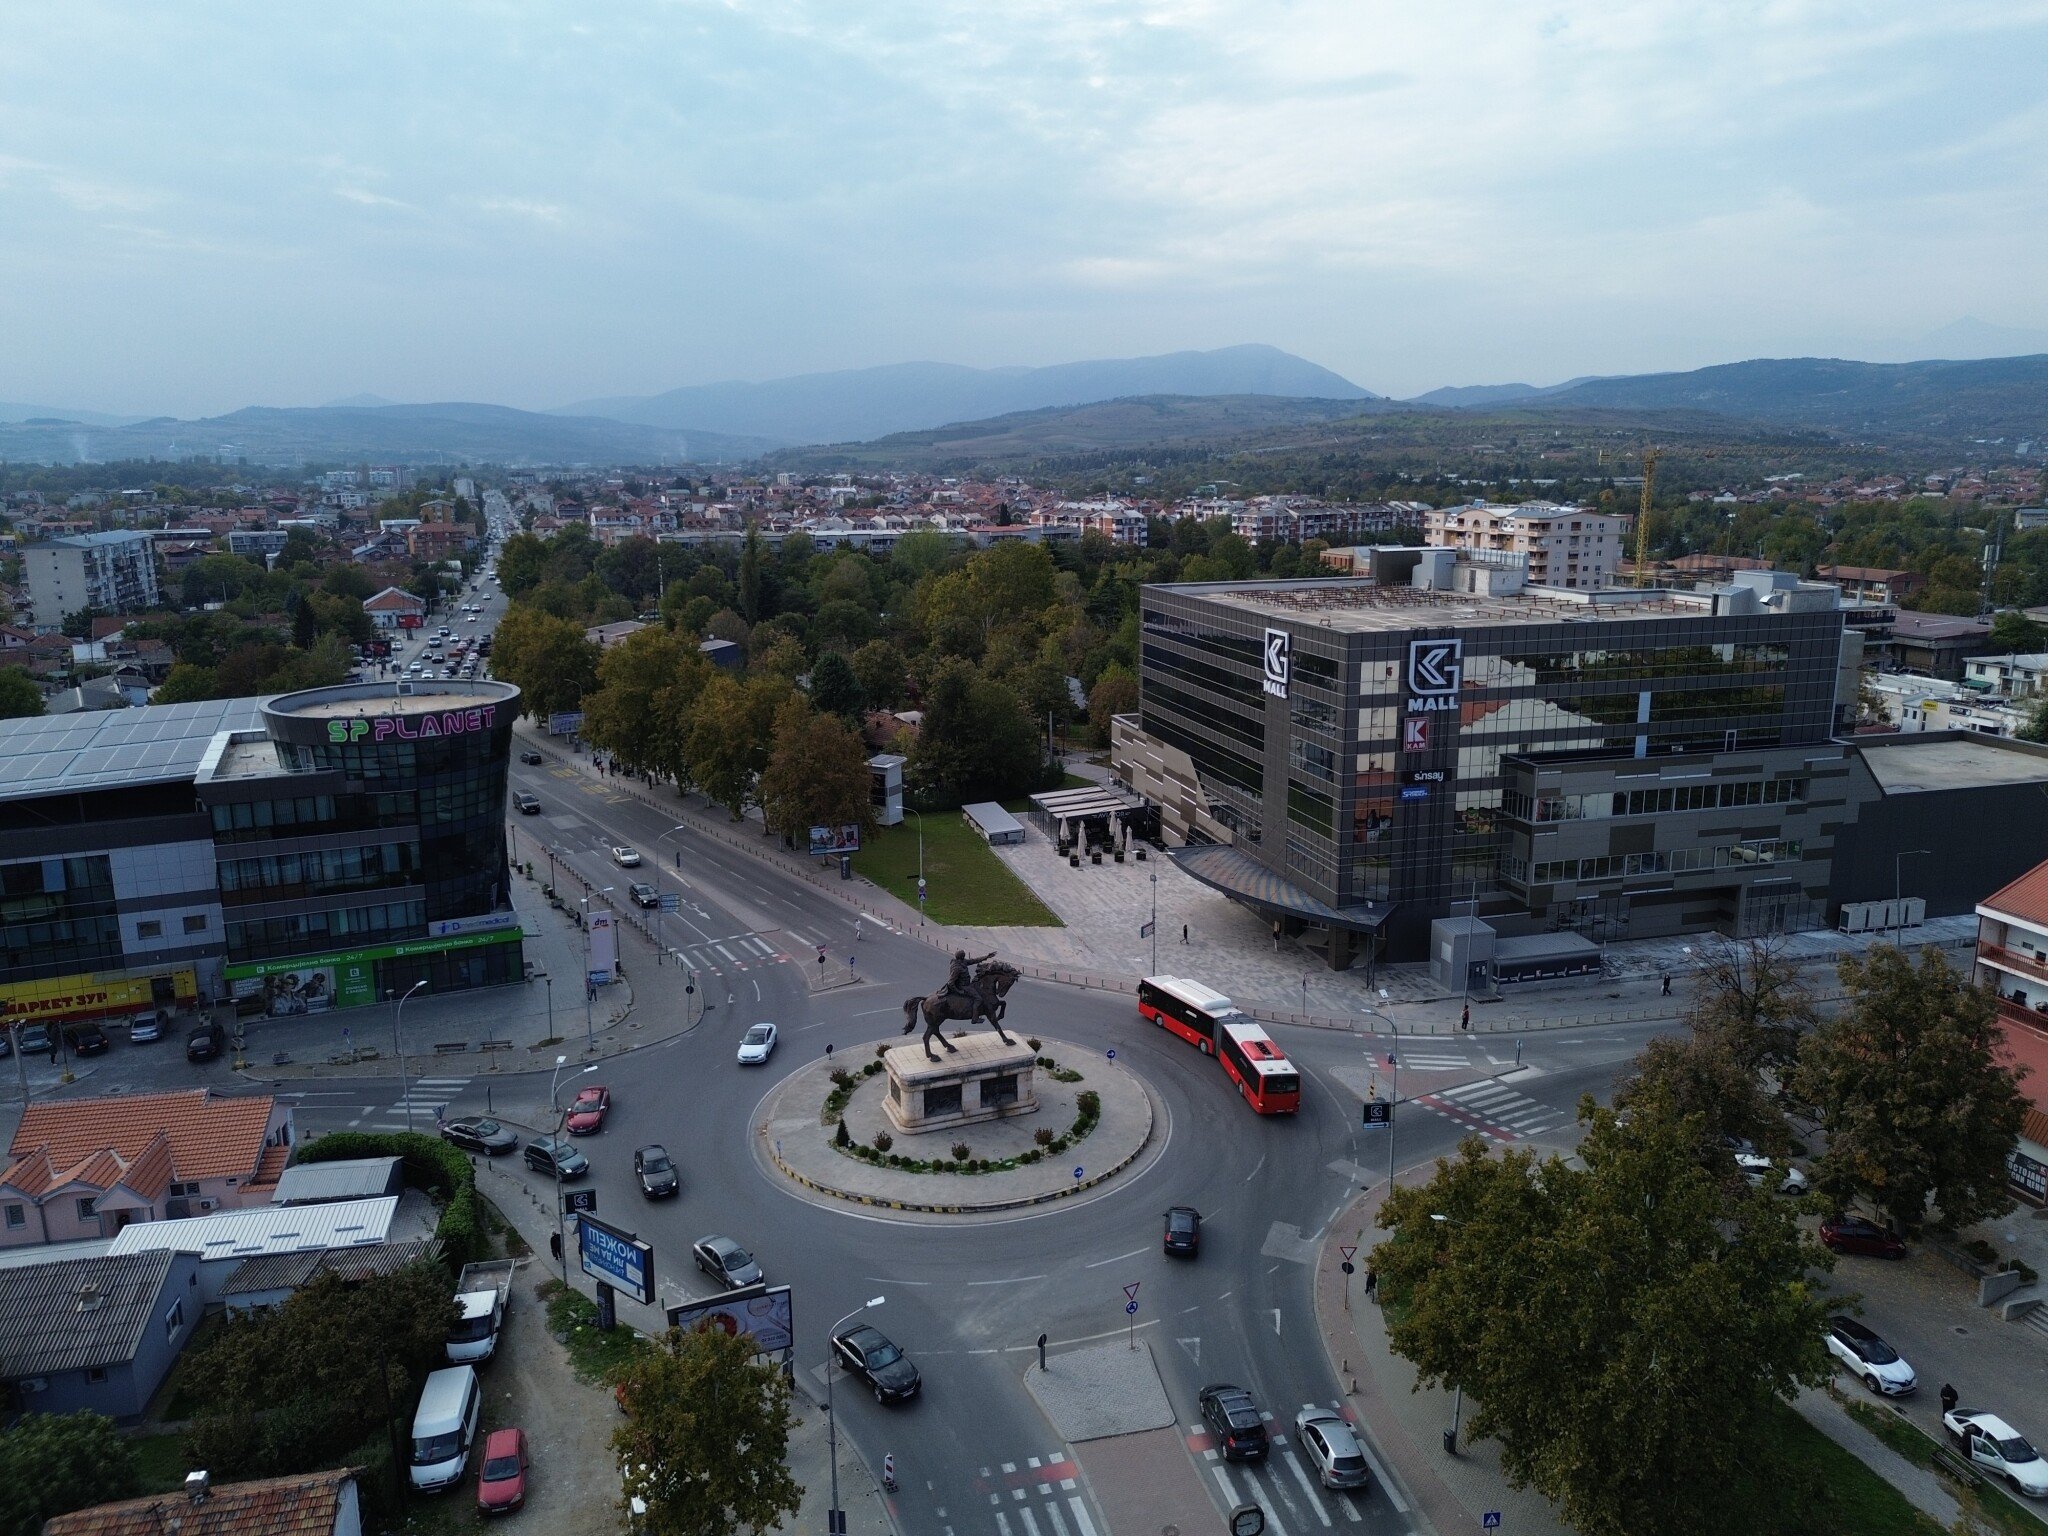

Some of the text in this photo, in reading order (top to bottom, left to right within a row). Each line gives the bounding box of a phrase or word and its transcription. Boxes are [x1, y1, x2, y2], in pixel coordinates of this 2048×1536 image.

[1263, 679, 1288, 699] MALL
[1407, 696, 1459, 712] MALL
[327, 705, 496, 742] SP PLANET
[1414, 770, 1444, 782] sinsay
[1098, 811, 1125, 819] AVIOR
[594, 918, 608, 927] dm
[478, 935, 494, 943] 24/7
[346, 953, 363, 961] 24/7
[4, 997, 74, 1016] МАРКЕТ
[2006, 1160, 2046, 1186] ОСТОЈАНО
[588, 1226, 637, 1264] МОЖЕШ
